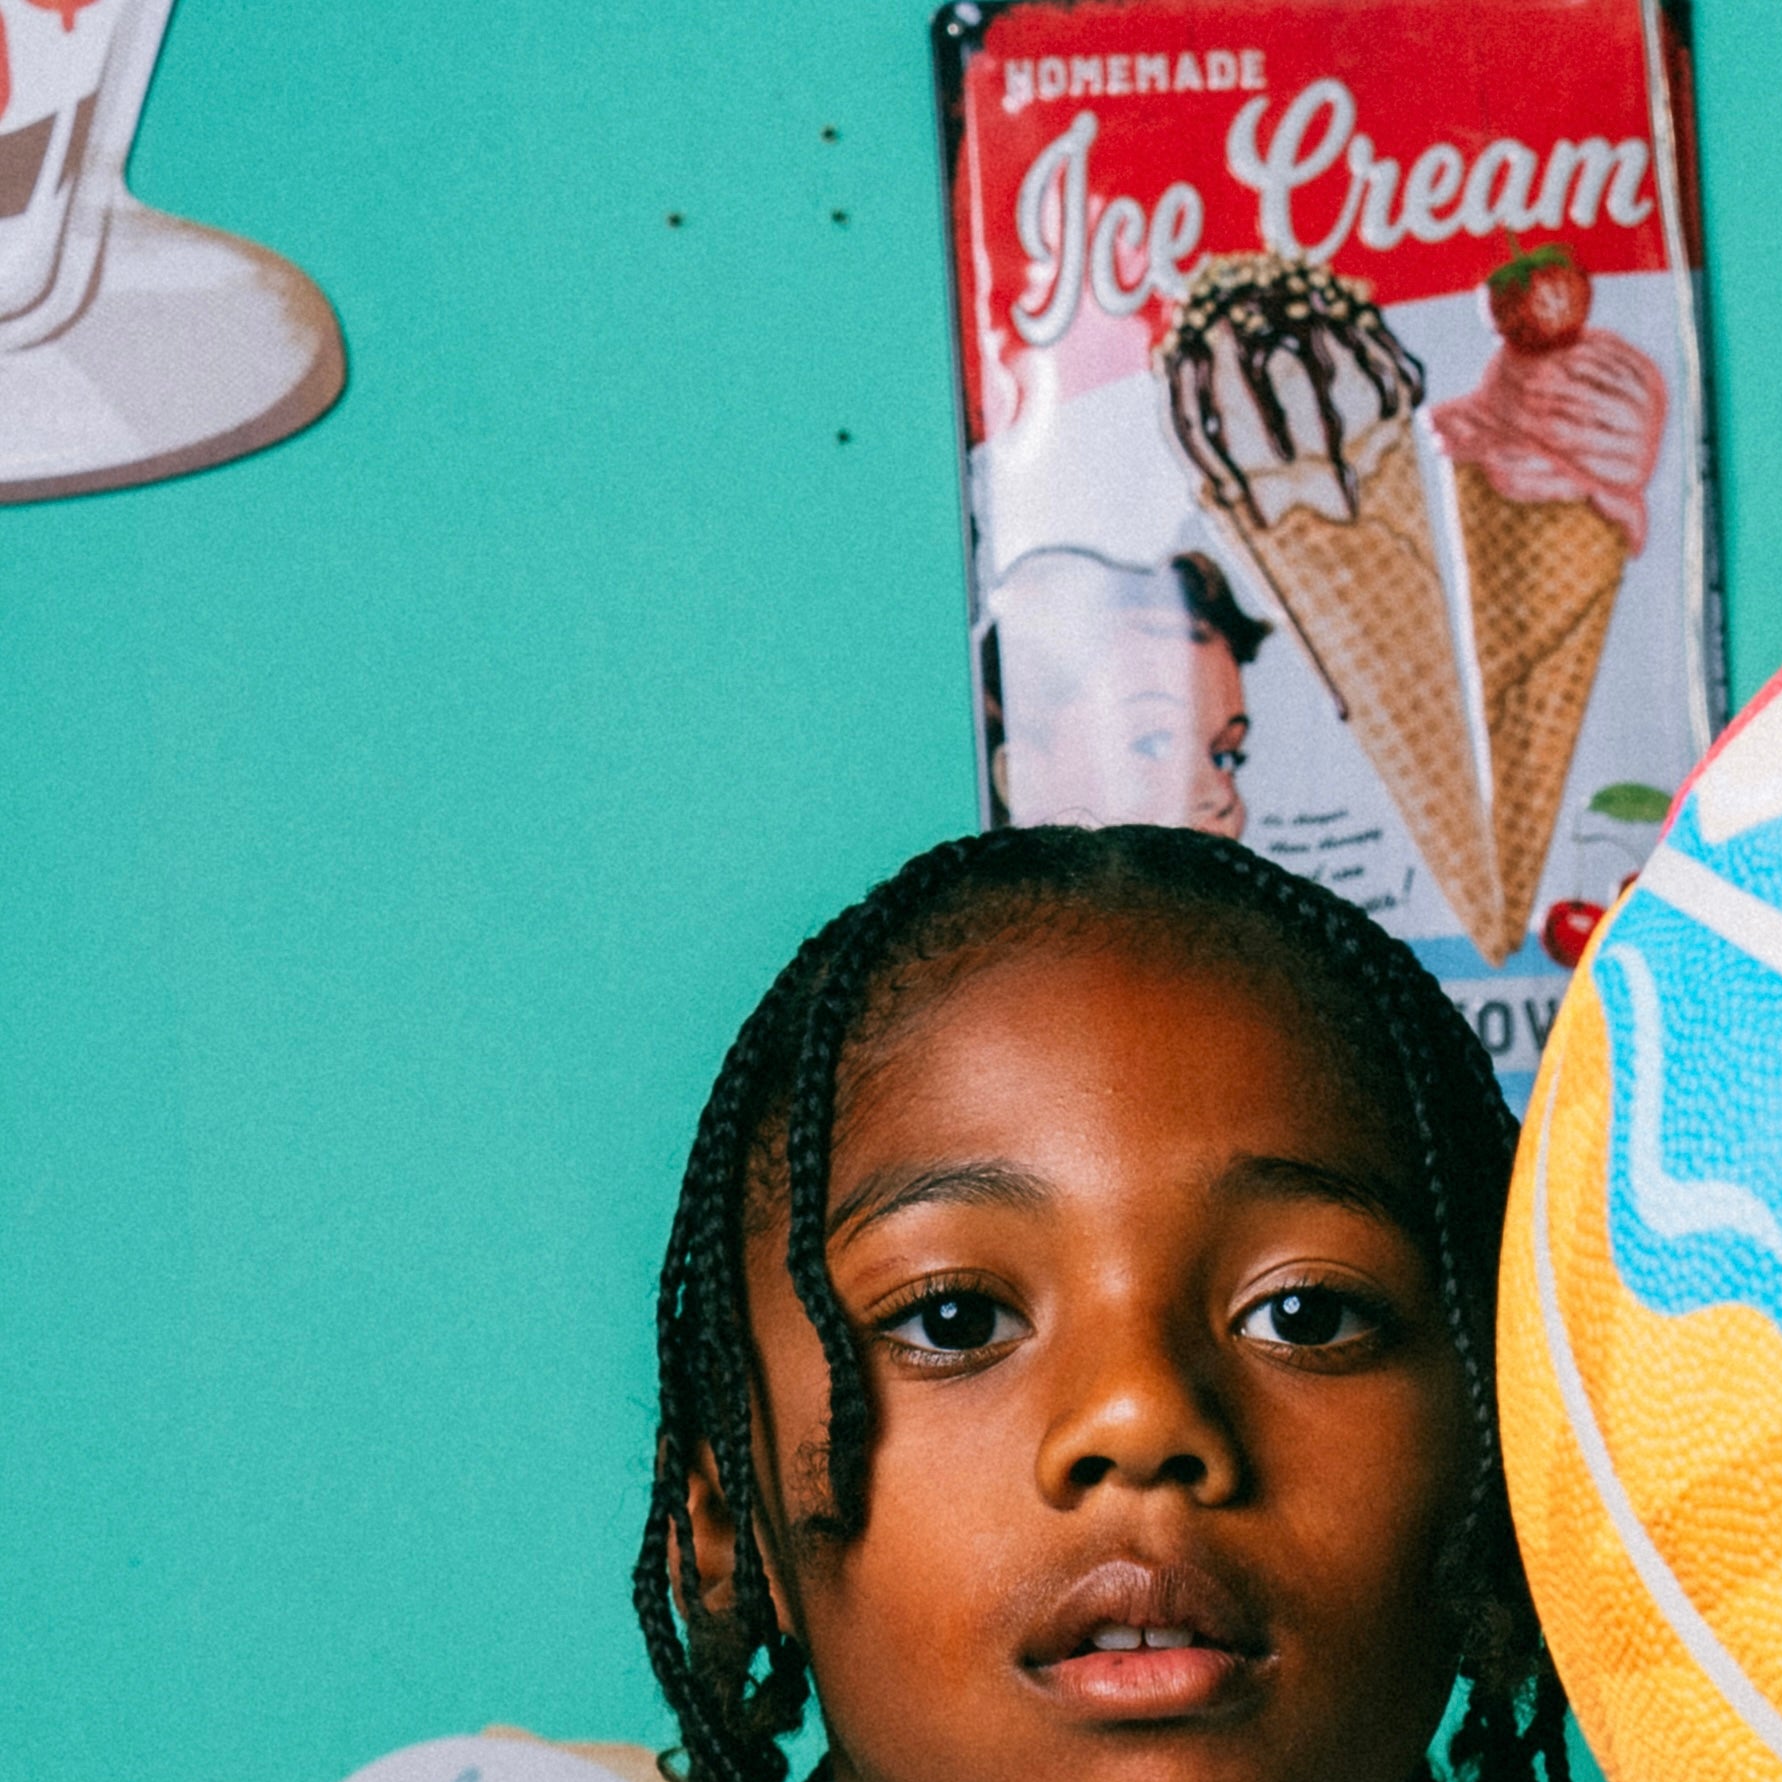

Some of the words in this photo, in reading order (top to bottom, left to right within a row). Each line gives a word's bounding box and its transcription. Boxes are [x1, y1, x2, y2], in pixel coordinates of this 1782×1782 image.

[1003, 50, 1266, 101] HOMEMADE
[1011, 110, 1212, 347] Ice
[1226, 78, 1654, 264] Cream
